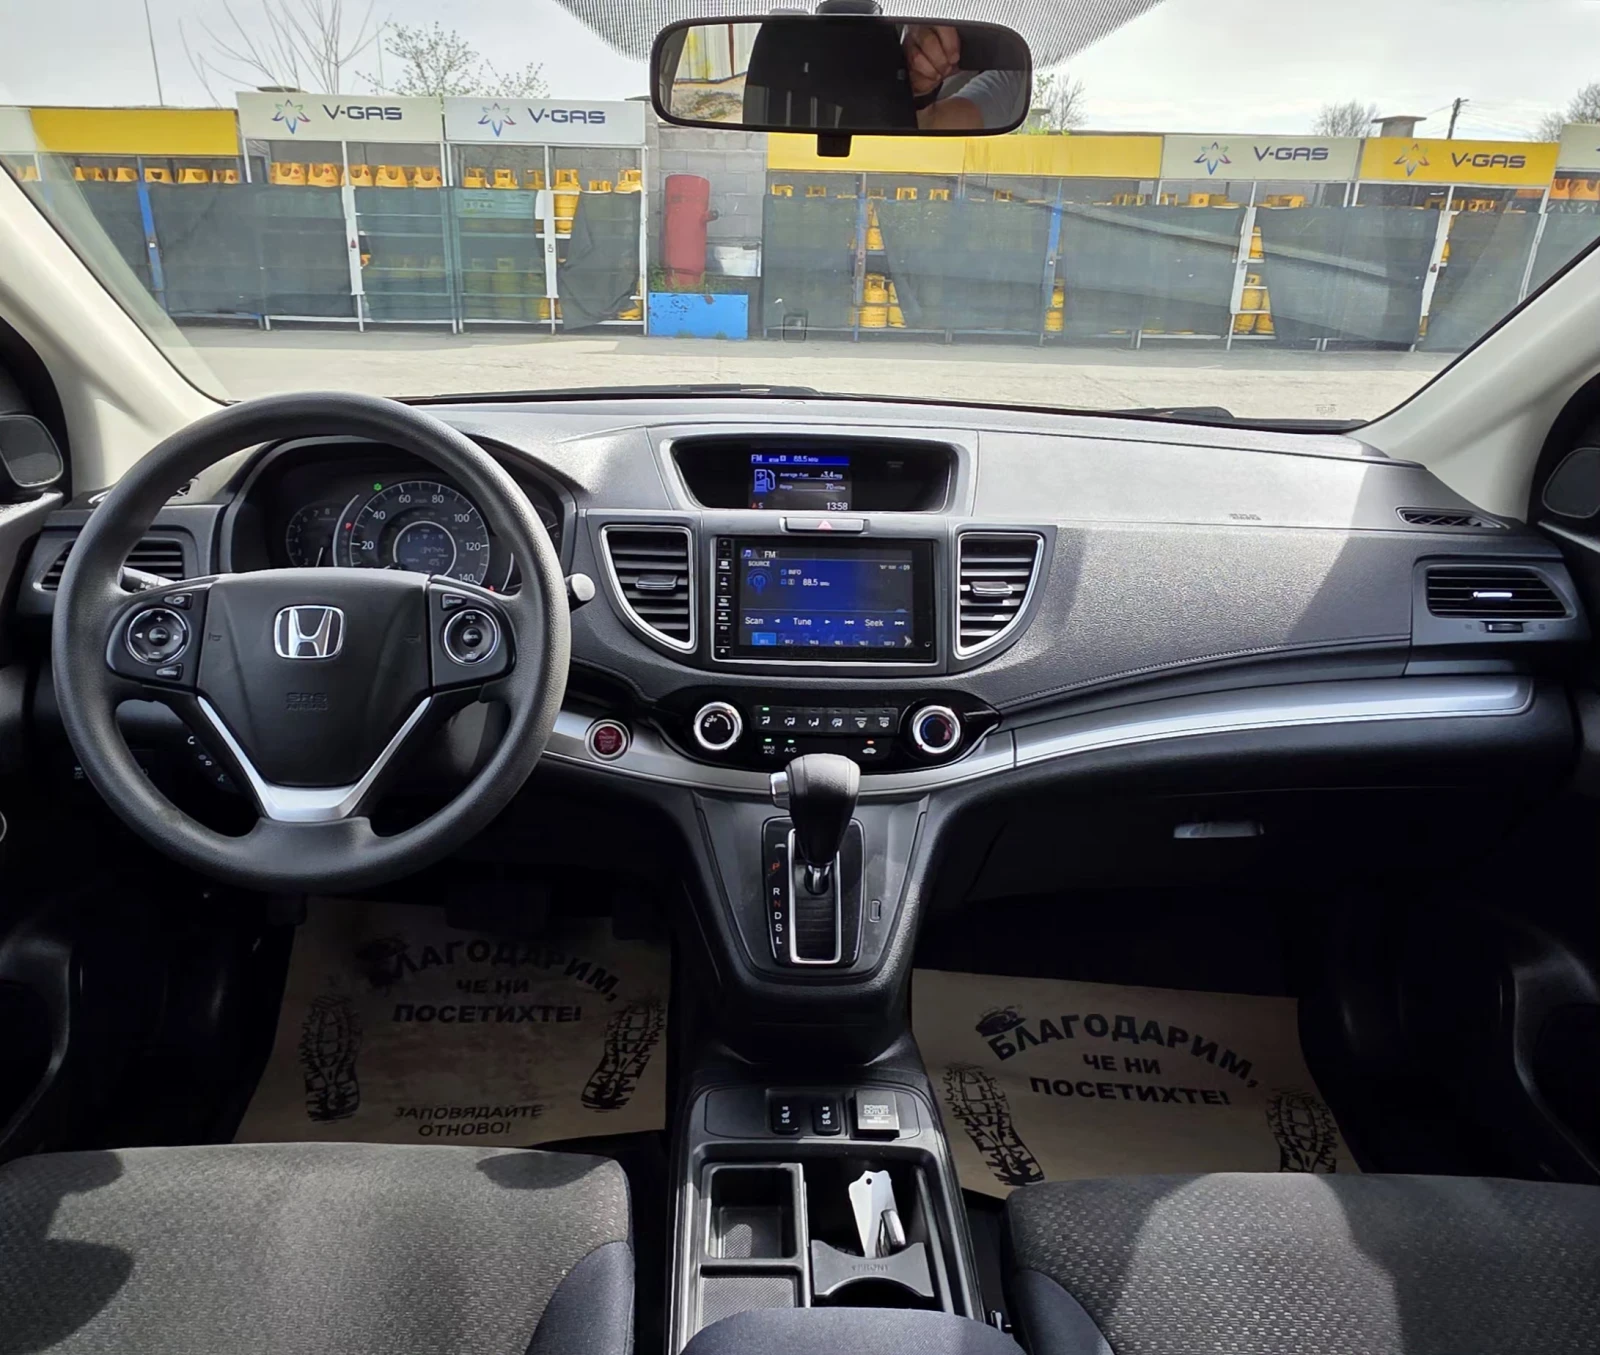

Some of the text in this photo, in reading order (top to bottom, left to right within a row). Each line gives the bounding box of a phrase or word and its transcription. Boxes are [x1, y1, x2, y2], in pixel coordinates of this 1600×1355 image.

[322, 104, 403, 121] V-GAS
[527, 108, 606, 124] V-GAS
[1253, 146, 1329, 162] V-GAS
[1451, 152, 1526, 169] V-GAS
[751, 454, 763, 462] FM
[398, 494, 411, 504] 60
[431, 494, 444, 504] 80
[372, 510, 386, 520] 40
[454, 513, 470, 523] 100
[361, 540, 374, 550] 20
[465, 542, 481, 551] 120
[764, 551, 776, 559] FM
[748, 560, 770, 568] SOURCE
[459, 573, 475, 582] 140
[802, 578, 819, 587] 88.5
[745, 616, 764, 625] Scan
[793, 617, 812, 626] Tune
[864, 618, 884, 627] Seek
[772, 861, 781, 870] P
[773, 887, 781, 895] R
[774, 912, 782, 920] D
[775, 923, 783, 932] S
[776, 937, 783, 945] L
[369, 940, 618, 1002] ЛАГОДАРИМ,
[456, 979, 530, 995] ЧЕ НИ
[392, 1004, 582, 1023] ПОСЕТИХТЕ!
[987, 1013, 1259, 1088] БЛАГОДАРИМ,
[1082, 1053, 1161, 1075] ЧЕ НИ
[1029, 1076, 1231, 1106] ПОСЕТИХТЕ!
[396, 1104, 545, 1121] ЗАПОВЯДАЙТЕ
[417, 1122, 511, 1137] ОТНОВО!
